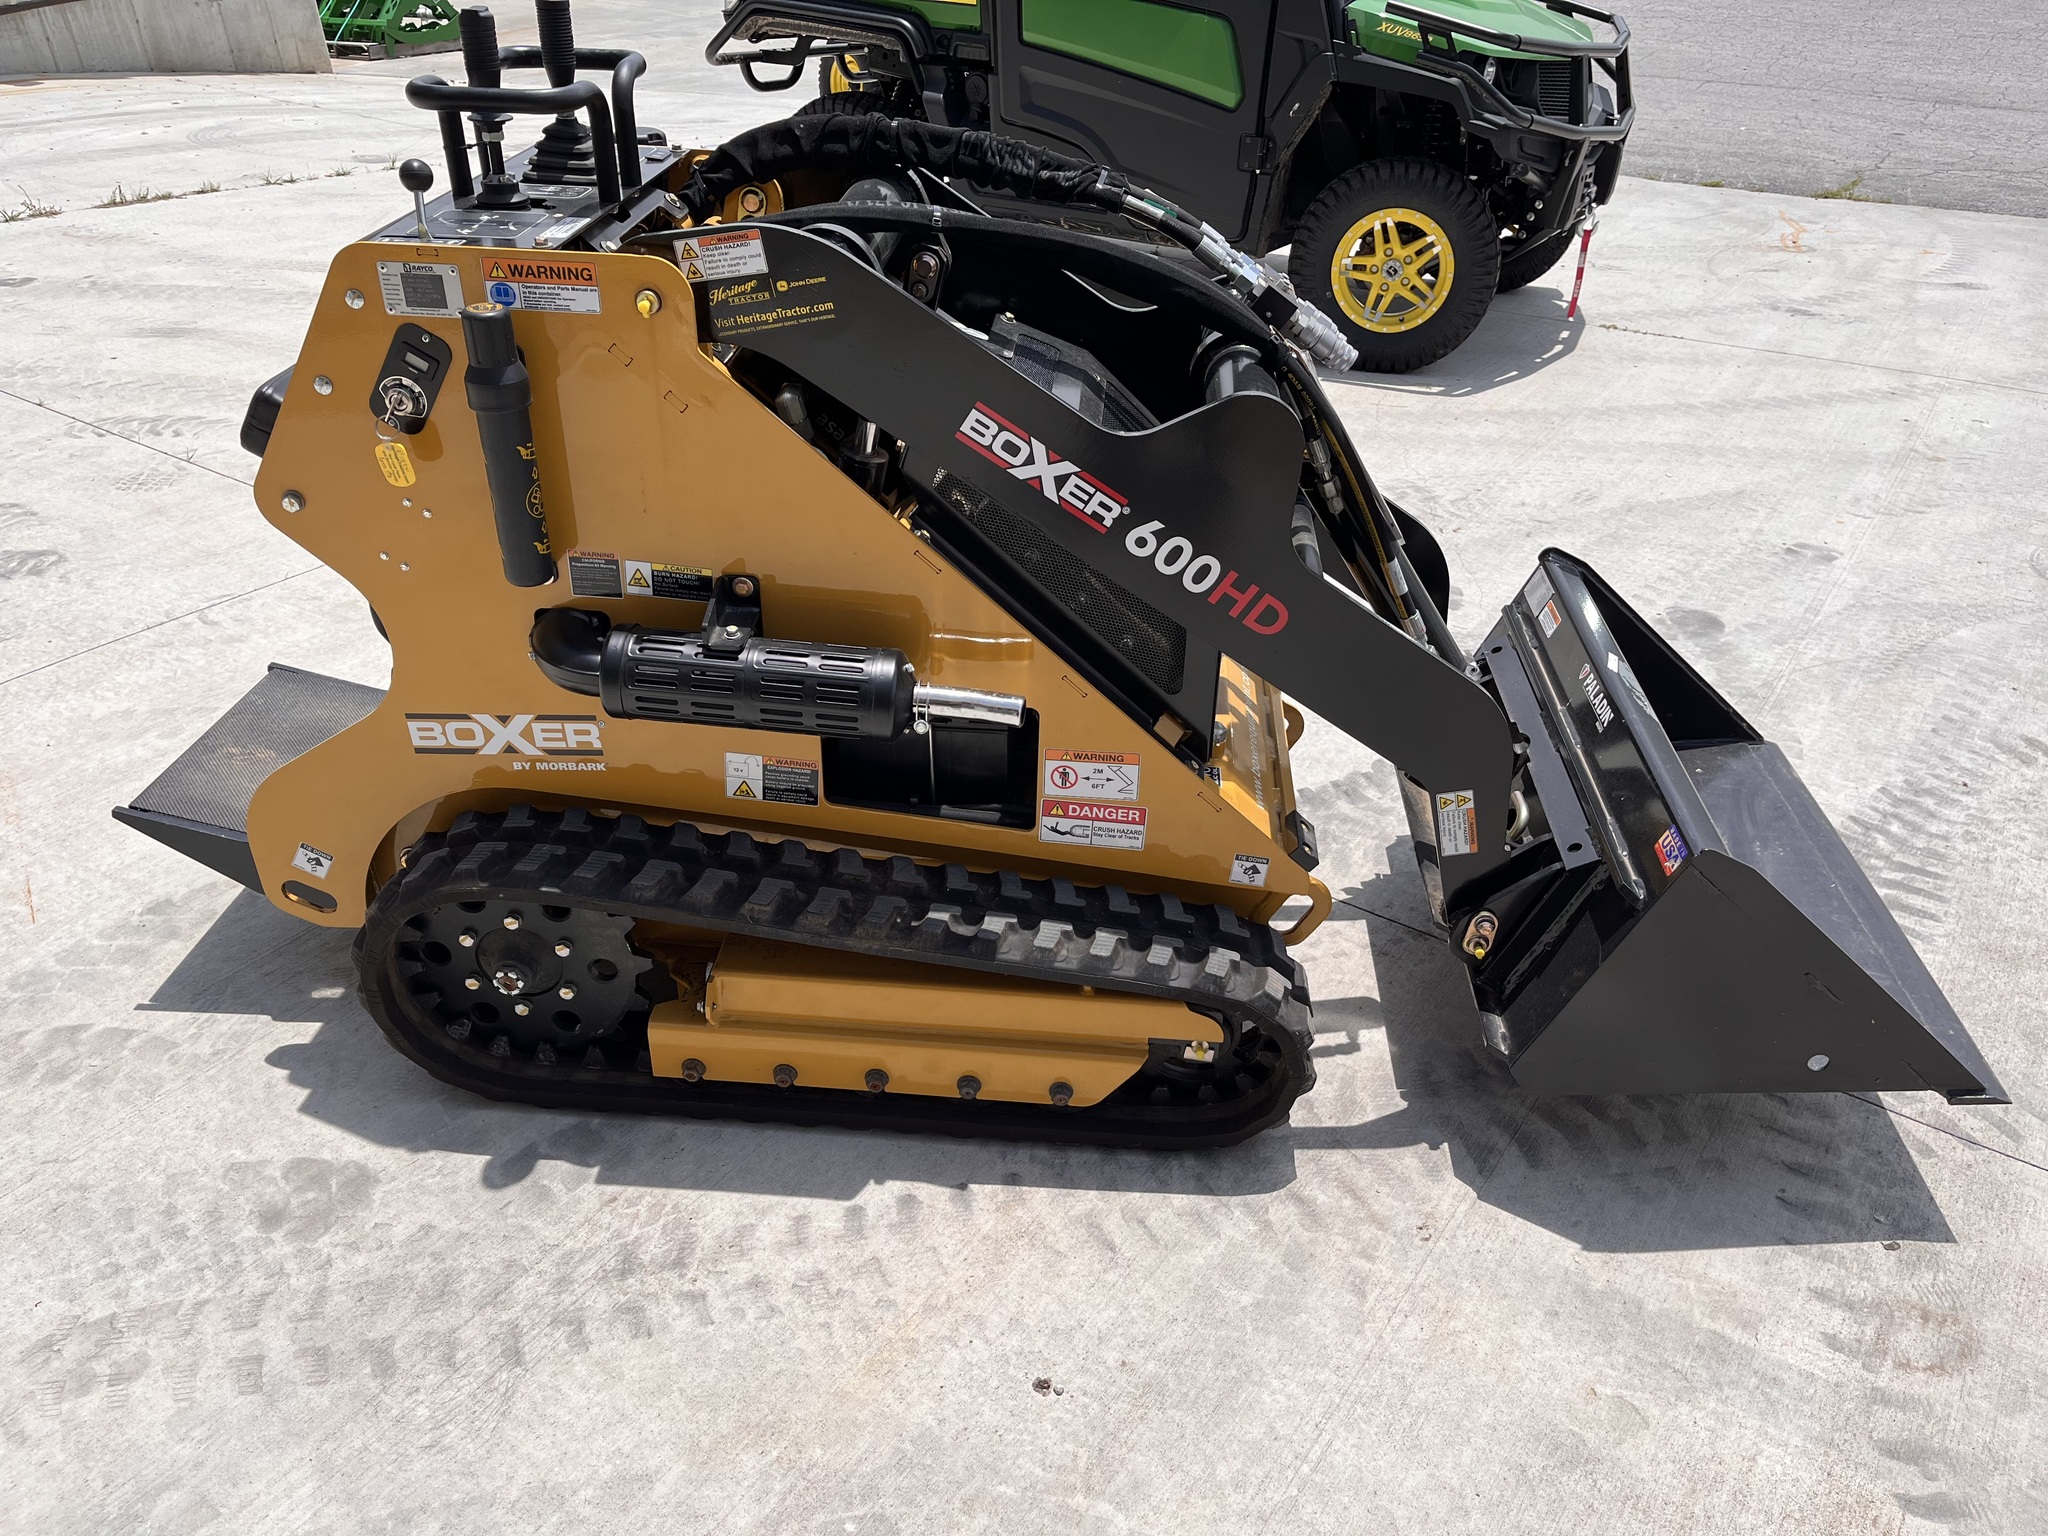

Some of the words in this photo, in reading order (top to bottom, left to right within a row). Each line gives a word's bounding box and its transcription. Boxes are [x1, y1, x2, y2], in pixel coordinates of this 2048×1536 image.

[717, 233, 749, 242] WARNING
[508, 264, 593, 281] WARNING
[806, 277, 826, 285] DEERE
[709, 280, 757, 306] Heritage
[729, 292, 770, 305] TRACTOR
[714, 318, 735, 328] Visit
[736, 302, 834, 324] HeritageTractor.com
[670, 566, 702, 574] CAUTION
[1583, 673, 1614, 727] PALADIN
[775, 759, 816, 768] WARNING
[1073, 753, 1124, 762] WARNING
[512, 762, 531, 771] BY
[536, 762, 607, 771] MORBARK
[1068, 805, 1140, 821] DANGER
[1670, 827, 1681, 847] MADE
[1680, 848, 1686, 857] IN
[303, 844, 312, 852] TIE
[313, 848, 331, 860] DOWN
[1661, 834, 1679, 869] USA
